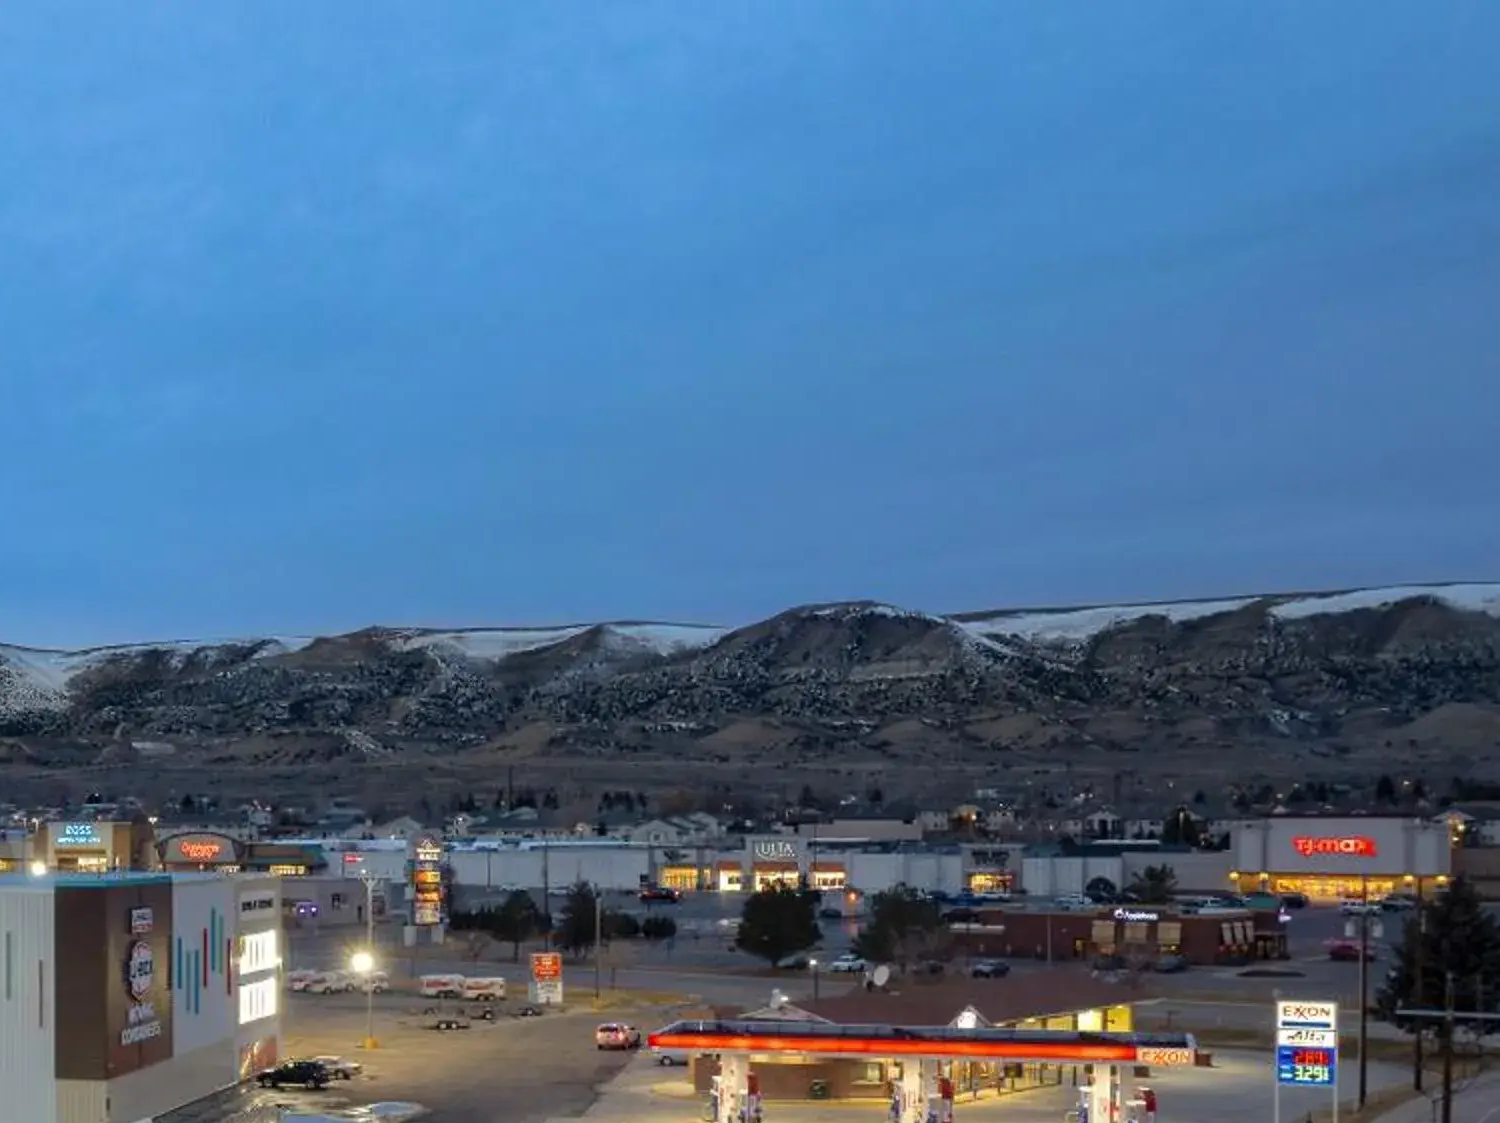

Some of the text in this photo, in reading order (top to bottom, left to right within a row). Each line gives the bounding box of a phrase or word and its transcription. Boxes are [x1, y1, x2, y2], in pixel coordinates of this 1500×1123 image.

[65, 825, 93, 836] ROSS
[1283, 1005, 1332, 1020] EXXON
[1141, 1050, 1190, 1067] EXXON
